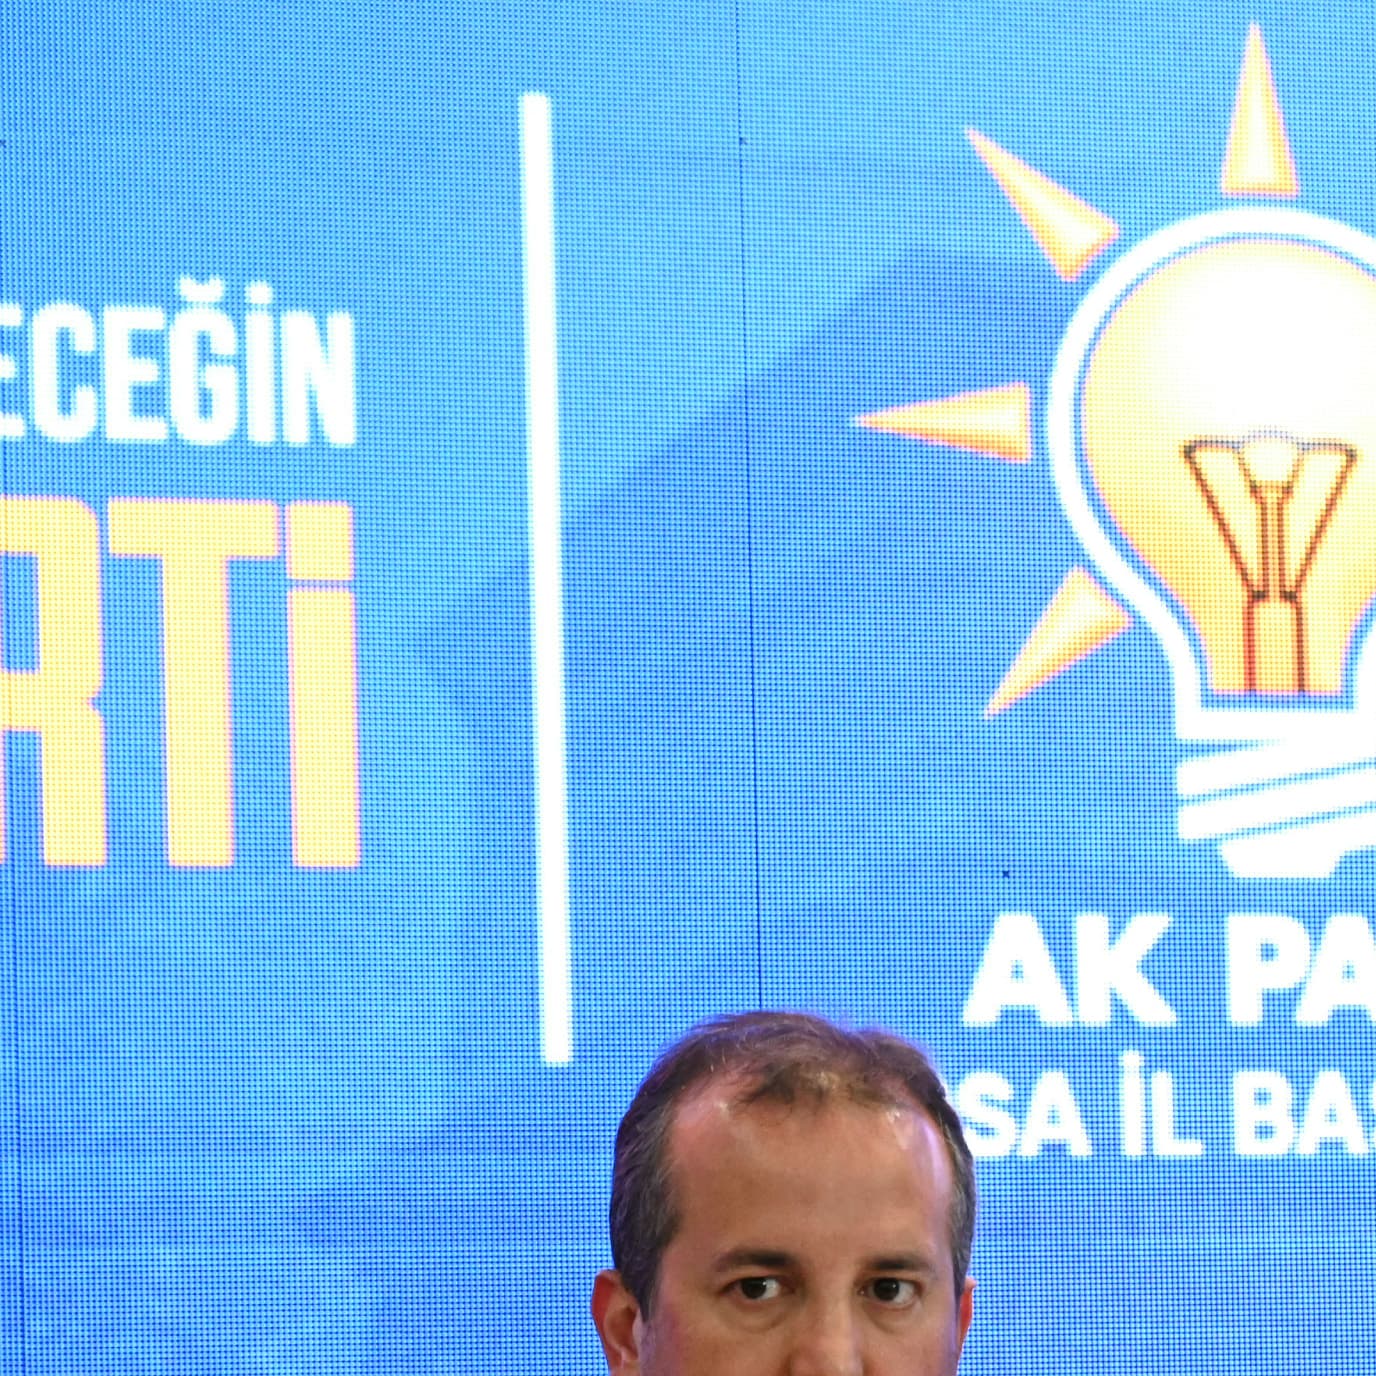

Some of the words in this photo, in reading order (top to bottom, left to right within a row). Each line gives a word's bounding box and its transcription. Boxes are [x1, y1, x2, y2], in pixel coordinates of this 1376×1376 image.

[962, 912, 1178, 1026] AK
[957, 1070, 1092, 1158] SA
[1118, 1050, 1203, 1158] İL
